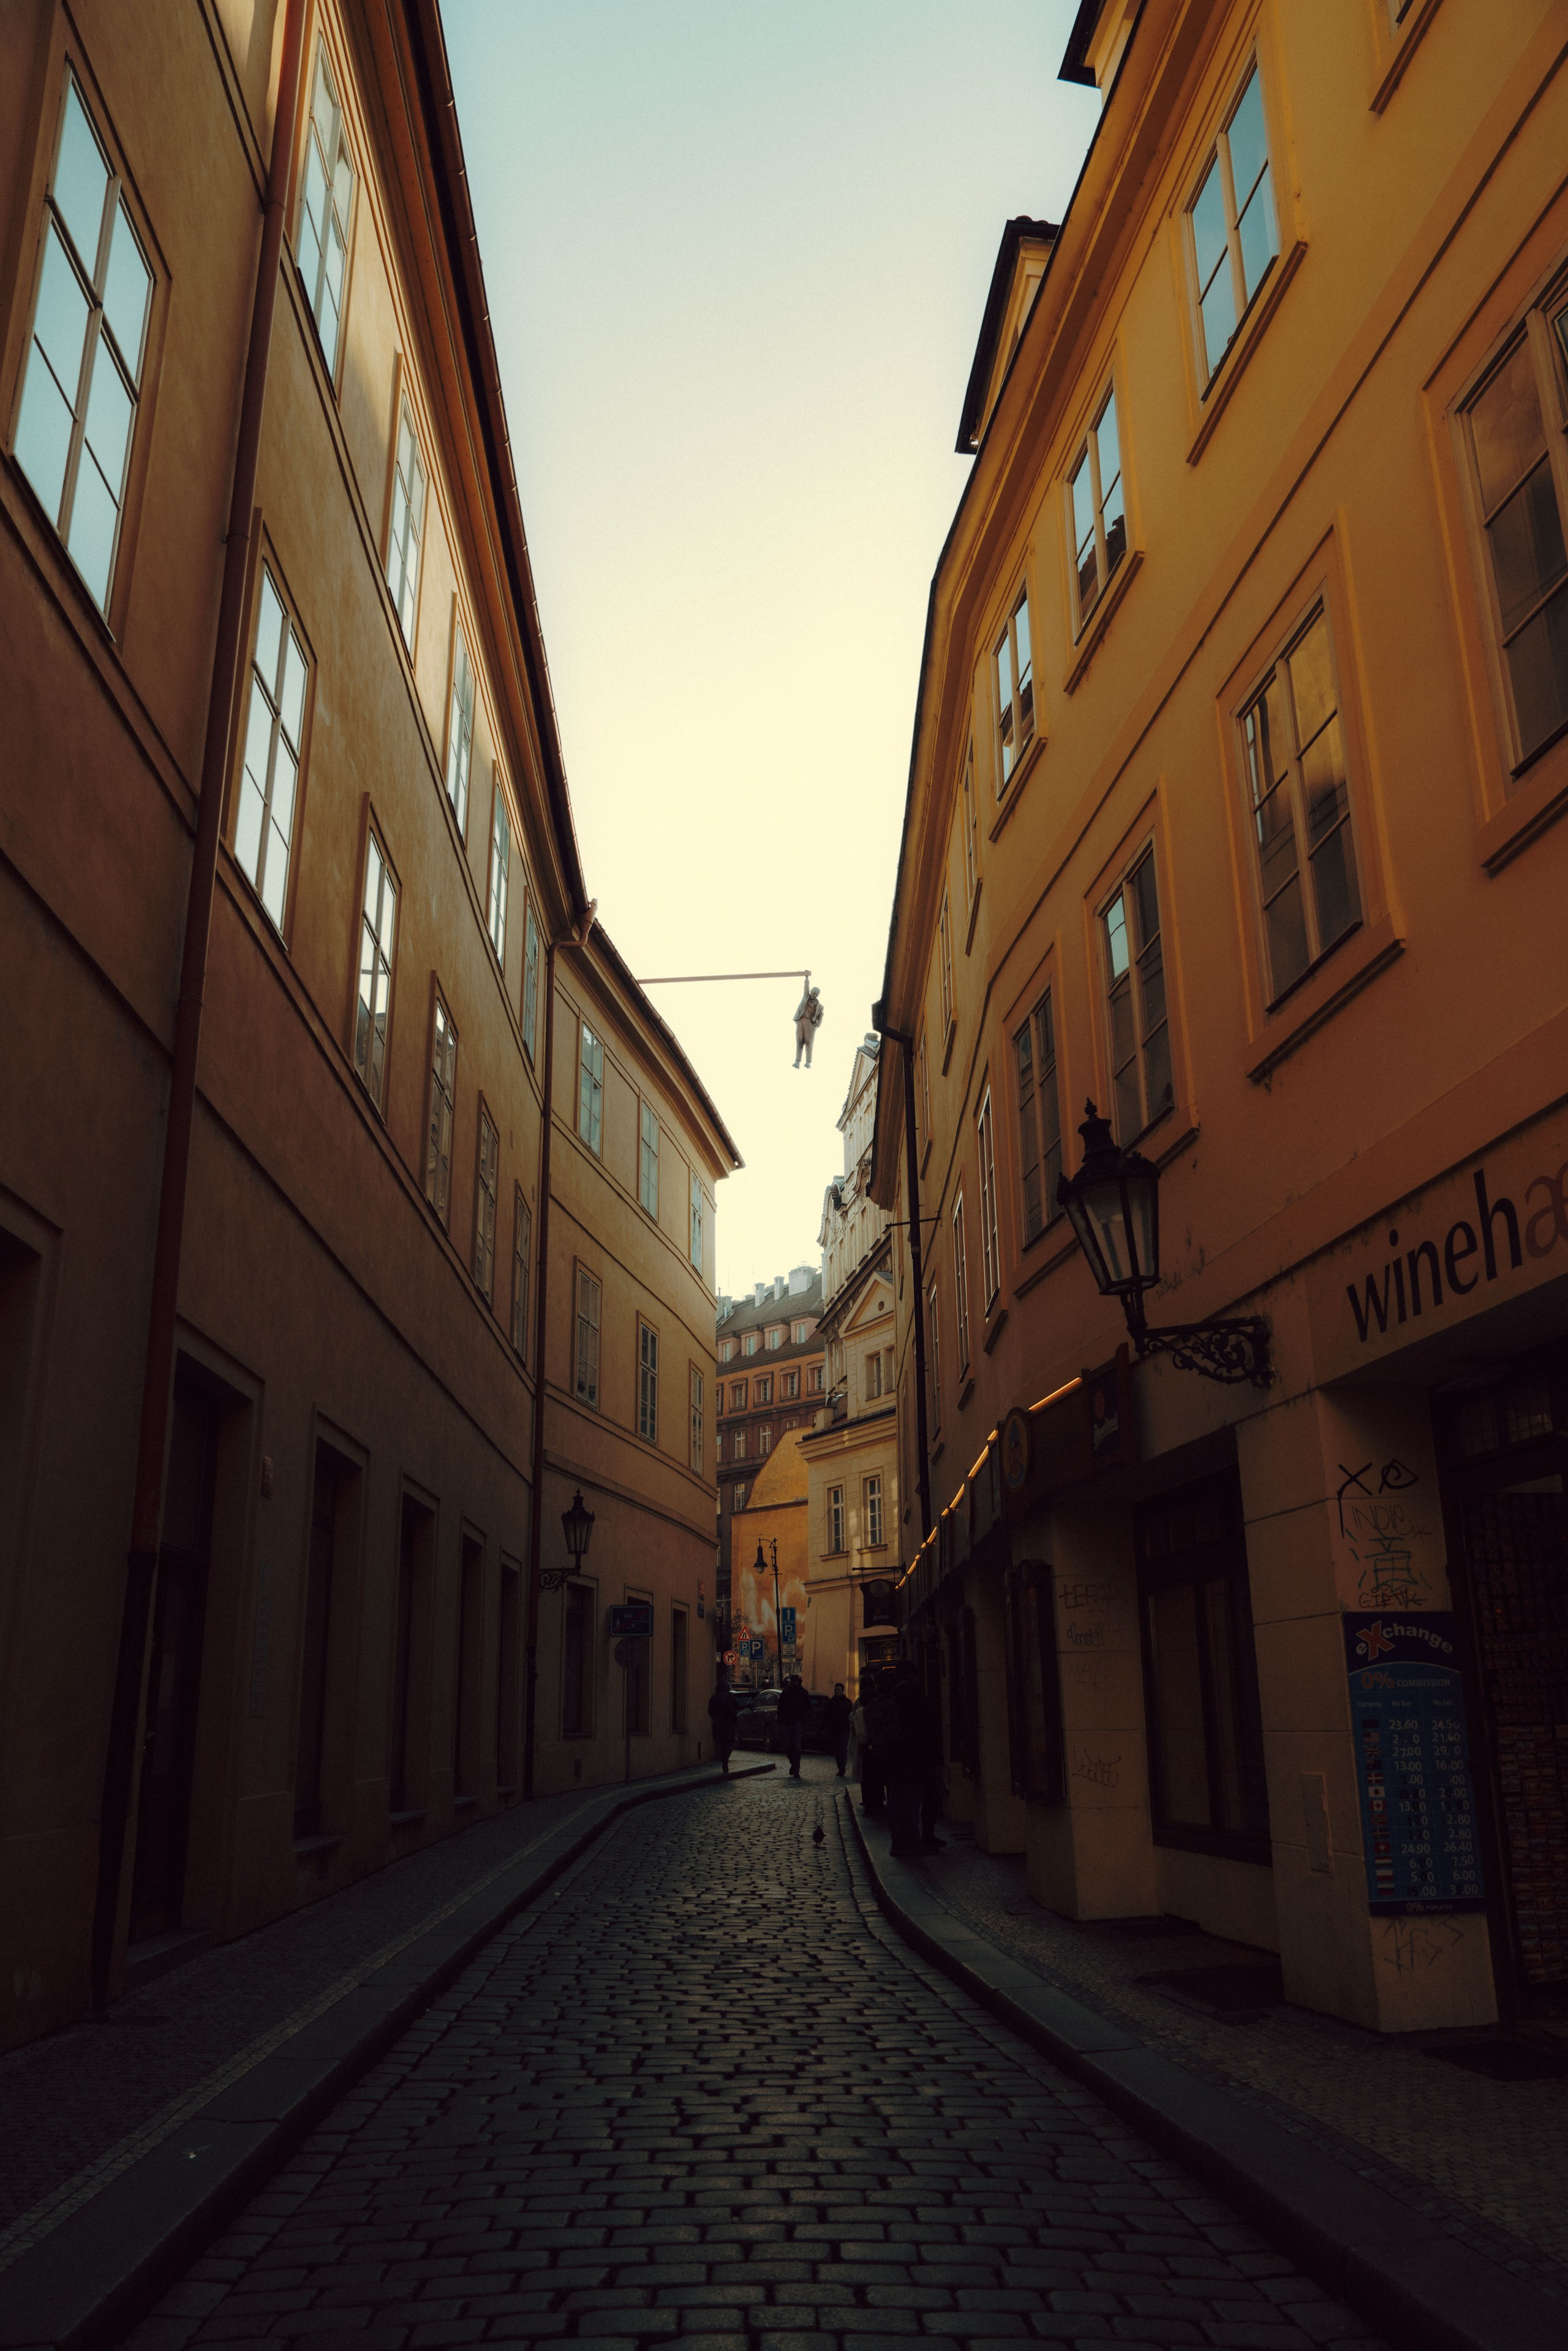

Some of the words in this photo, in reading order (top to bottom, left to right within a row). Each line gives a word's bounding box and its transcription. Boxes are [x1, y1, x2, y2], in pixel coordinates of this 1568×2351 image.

[785, 1624, 793, 1636] P
[1355, 1620, 1453, 1661] eXchange
[752, 1641, 761, 1654] P
[1361, 1671, 1395, 1689] 0%
[1396, 1678, 1450, 1688] COMMISSION
[1389, 1719, 1418, 1730] 23.60
[1393, 1747, 1421, 1758] 27.00
[1395, 1761, 1422, 1771] 13.00
[1435, 1759, 1464, 1770] 16.00
[1446, 1814, 1471, 1825] 2.80
[1449, 1828, 1472, 1839] 2.80
[1401, 1843, 1430, 1854] 24.90
[1443, 1841, 1473, 1852] 26.40
[1451, 1855, 1474, 1867] 7.50
[1452, 1870, 1476, 1881] 6.00
[1406, 1902, 1425, 1912] 0%
